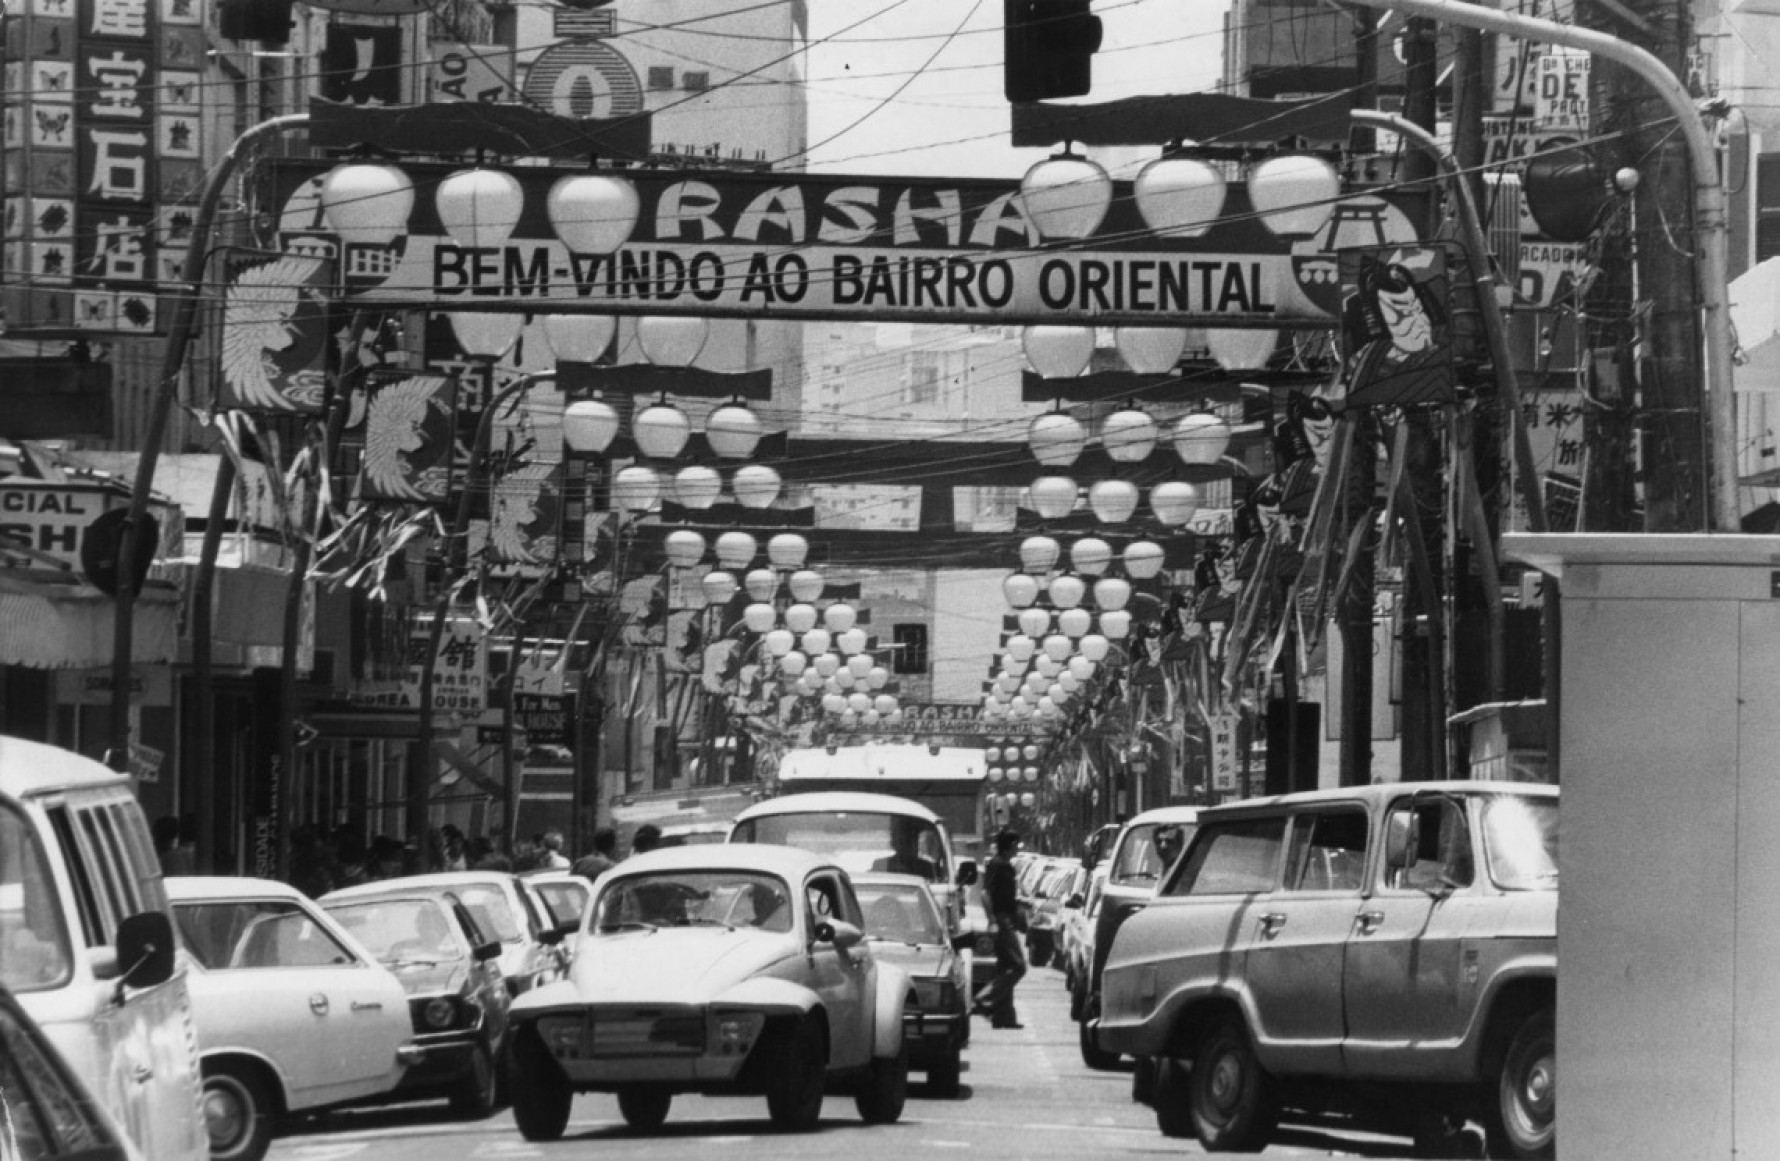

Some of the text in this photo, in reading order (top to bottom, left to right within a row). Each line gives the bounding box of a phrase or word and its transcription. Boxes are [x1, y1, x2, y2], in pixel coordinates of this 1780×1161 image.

[655, 180, 1040, 247] RASHA
[433, 245, 1276, 314] BEM-VINDO AO BAIRRO ORIENTAL
[3, 492, 85, 515] CIAL
